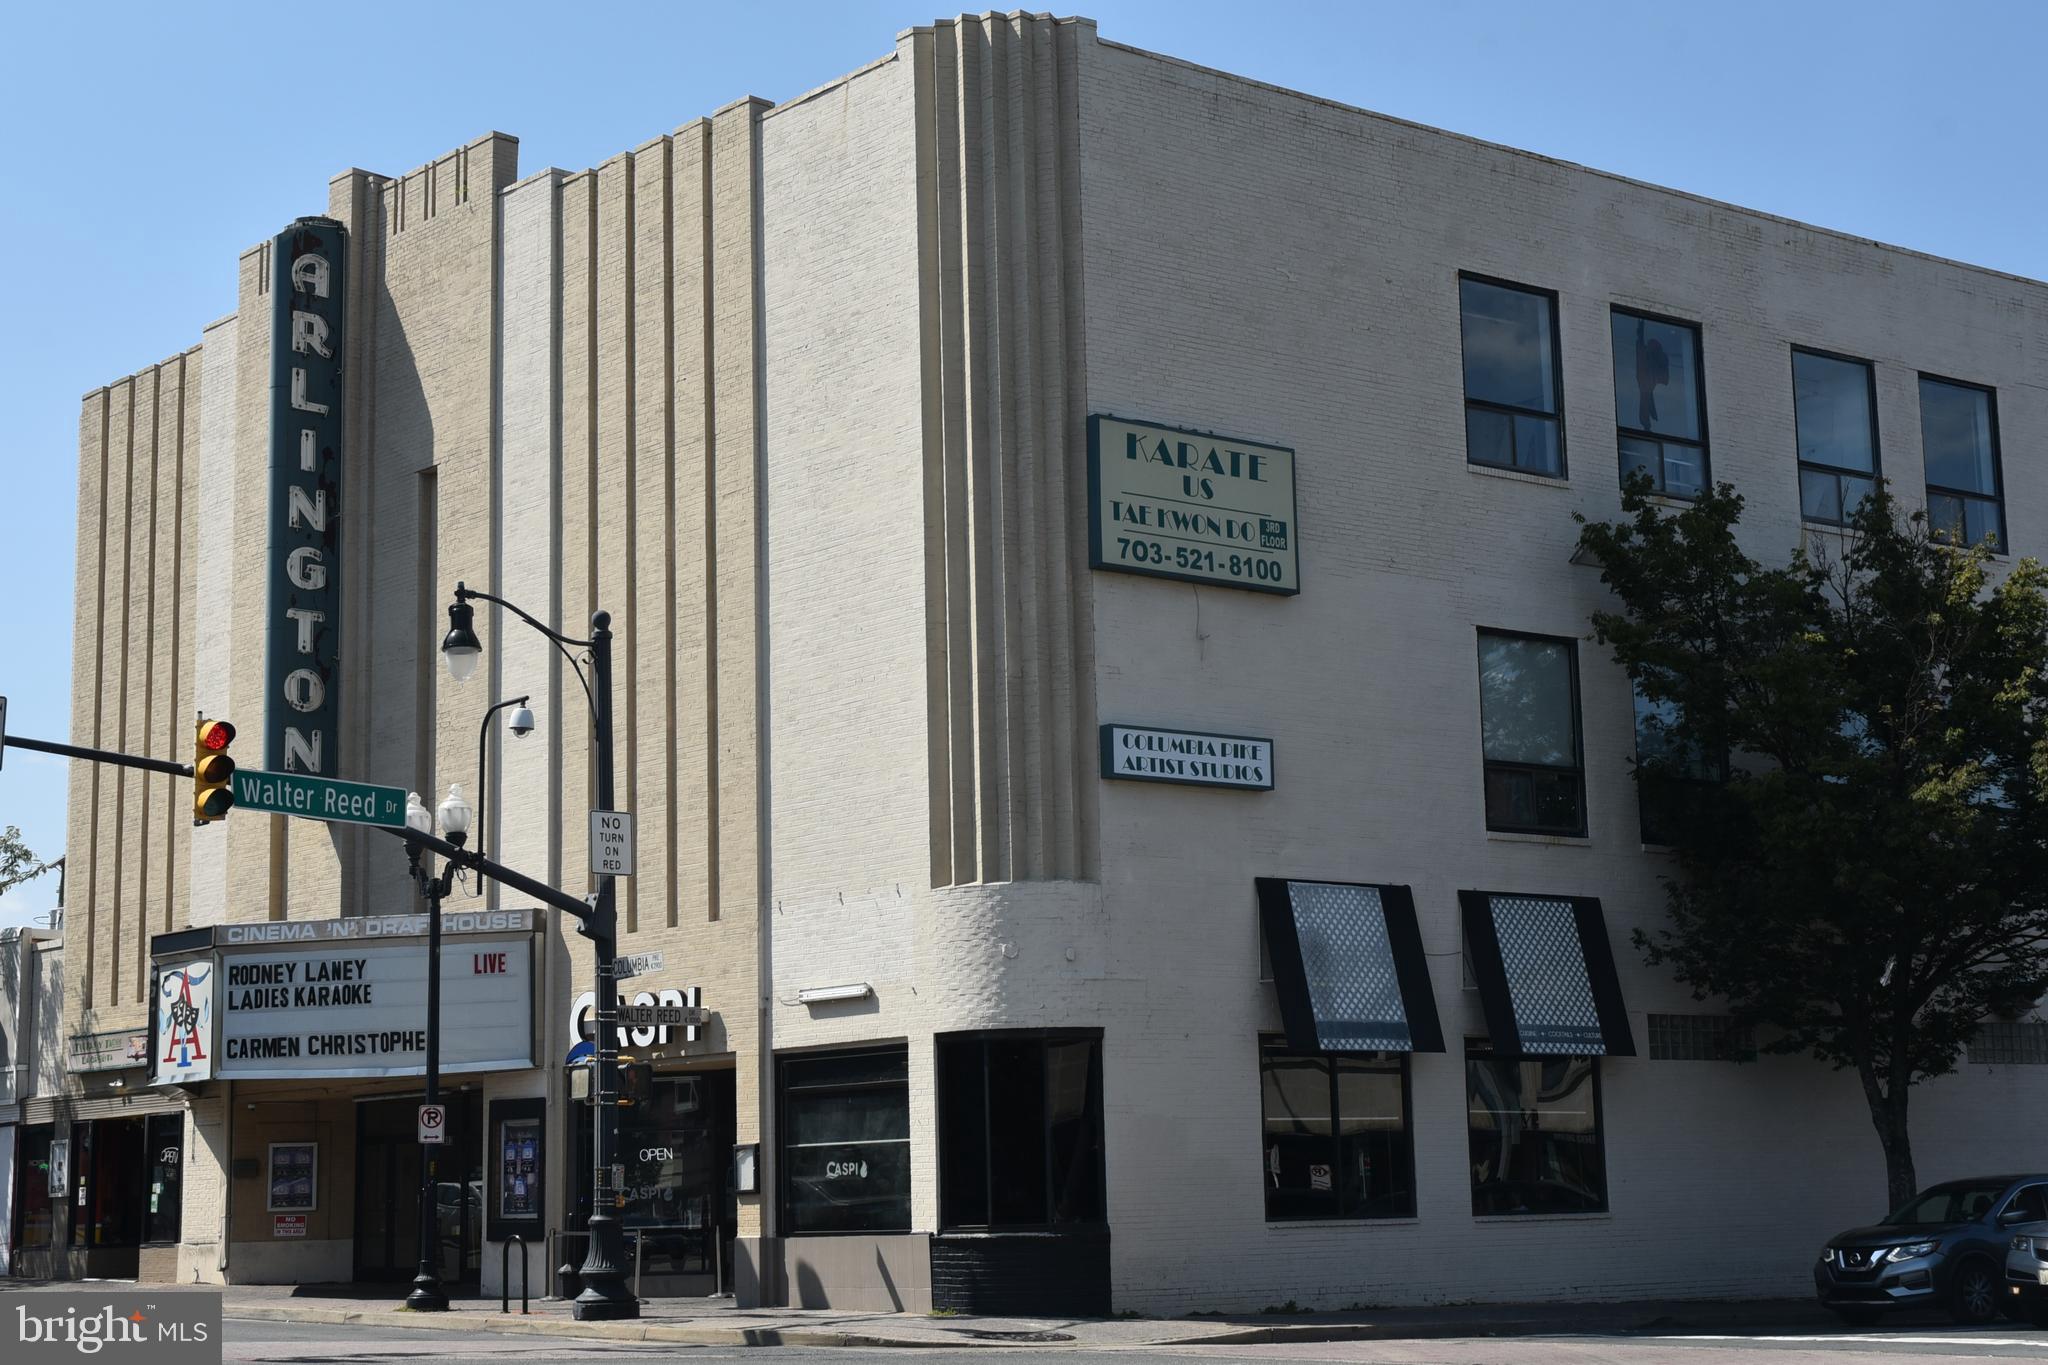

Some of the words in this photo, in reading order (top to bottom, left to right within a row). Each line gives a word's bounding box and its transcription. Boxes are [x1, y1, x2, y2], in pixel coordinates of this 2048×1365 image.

[1126, 432, 1268, 482] KARATE
[1183, 475, 1215, 500] US
[282, 252, 334, 774] ARLINGTON
[1109, 500, 1152, 527] TAE
[1157, 508, 1221, 537] KWON
[1226, 519, 1256, 542] DO
[1265, 520, 1281, 534] 3RD
[1261, 534, 1287, 549] FLOOR
[1117, 537, 1283, 582] 703-521-8100
[1122, 733, 1217, 757] COLUMBIA
[1220, 742, 1264, 760] PIKE
[1122, 755, 1185, 775] ARTIST
[1189, 760, 1264, 782] STUDIOS
[241, 777, 315, 811] Walter
[324, 787, 376, 818] Reed
[385, 799, 399, 814] Dr
[601, 816, 621, 830] NO
[599, 832, 624, 843] TURN
[604, 846, 619, 857] ON
[602, 859, 621, 870] RED
[227, 924, 316, 942] CINEMA
[365, 913, 522, 936] DRAFHOUSE
[228, 963, 297, 985] RODNEY
[304, 959, 368, 982] LANEY
[473, 953, 507, 974] LIVE
[613, 957, 650, 975] COLUMBIA
[228, 988, 290, 1010] LADIES
[293, 984, 373, 1007] KARAOKE
[569, 986, 702, 1048] CSPI
[618, 1008, 653, 1023] WALTER
[656, 1009, 681, 1023] REED
[226, 1037, 300, 1059] CARMEN
[639, 1147, 673, 1162] OPEN
[825, 1160, 859, 1179] CASPI
